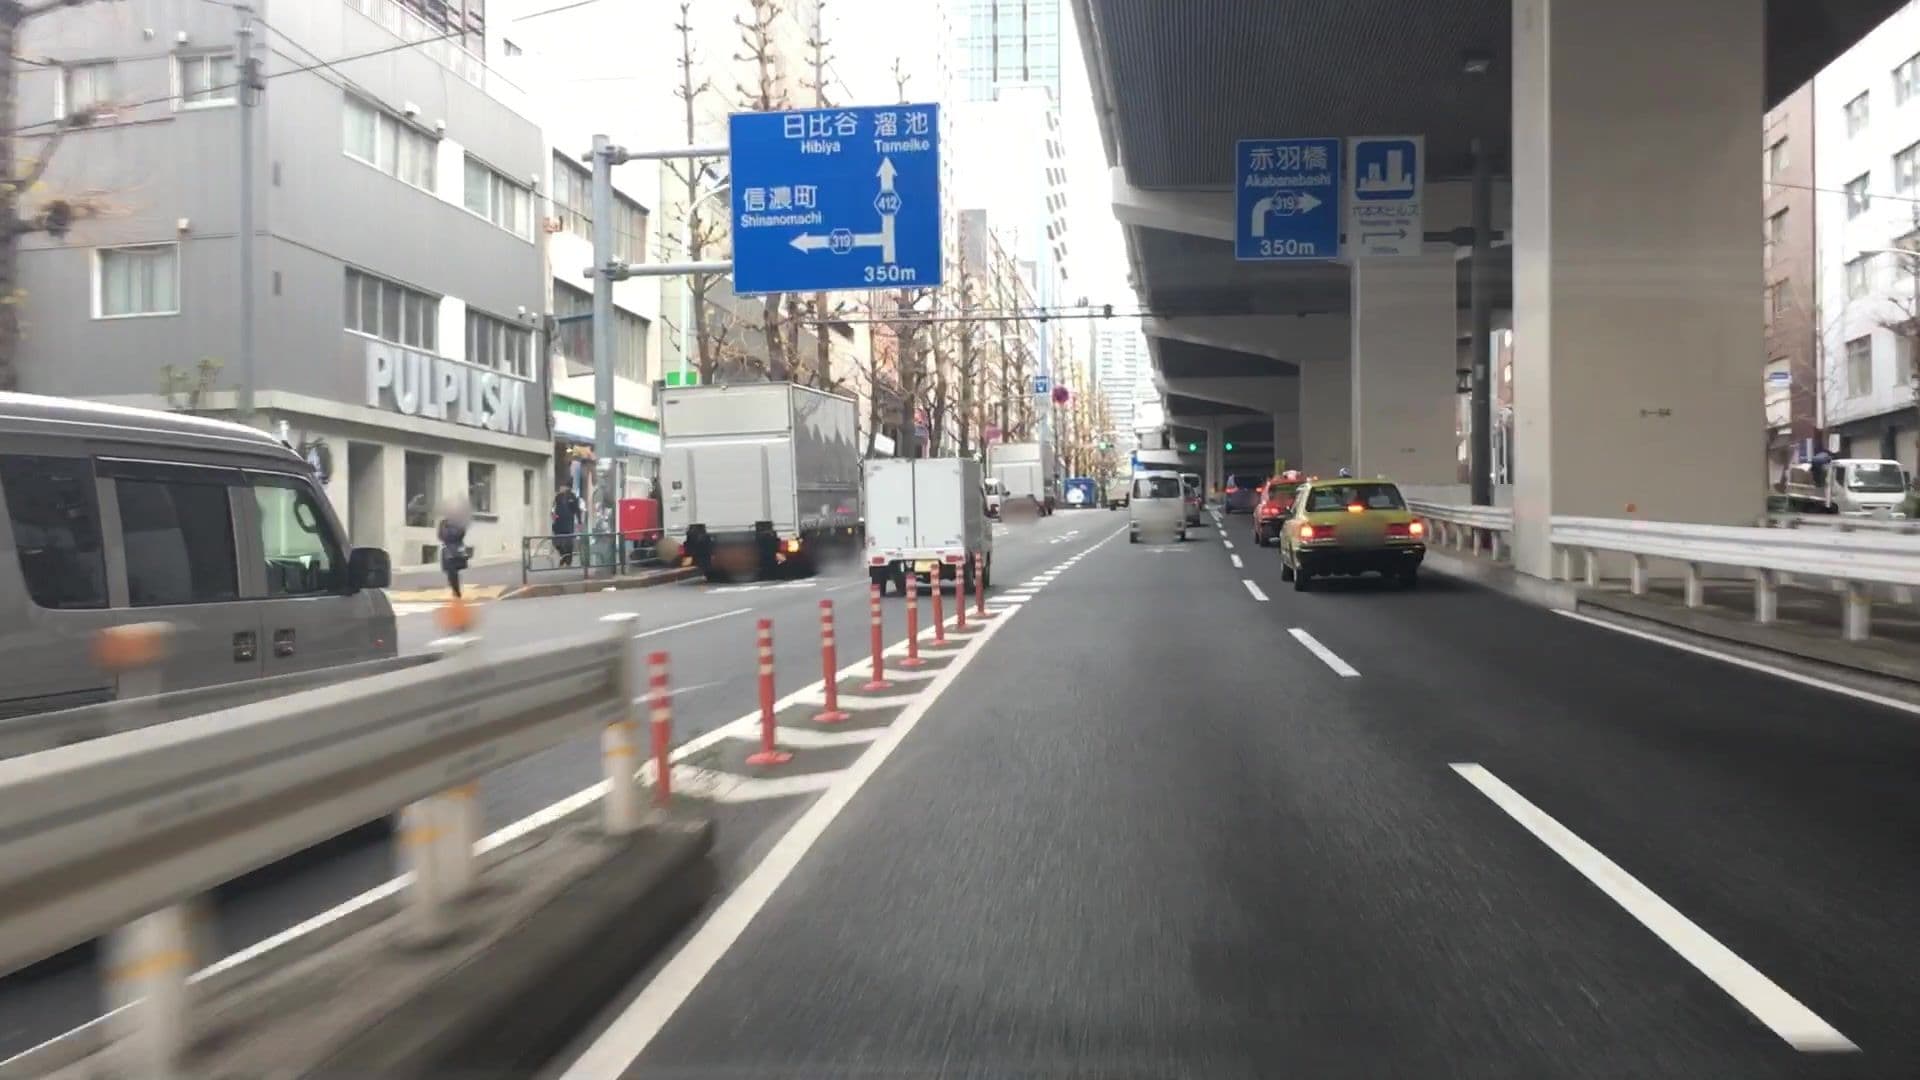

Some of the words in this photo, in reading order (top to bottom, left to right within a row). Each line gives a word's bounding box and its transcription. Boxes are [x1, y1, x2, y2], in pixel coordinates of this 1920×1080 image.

[784, 113, 858, 138] 日比谷
[801, 140, 841, 155] Hibiya
[1250, 146, 1328, 170] 赤羽橋
[743, 185, 818, 211] 信濃町
[878, 197, 897, 210] 412
[1276, 196, 1295, 210] 319
[740, 212, 822, 228] Shinanomachi
[832, 235, 851, 248] 319
[1260, 239, 1315, 256] 350m
[864, 266, 916, 282] 350m
